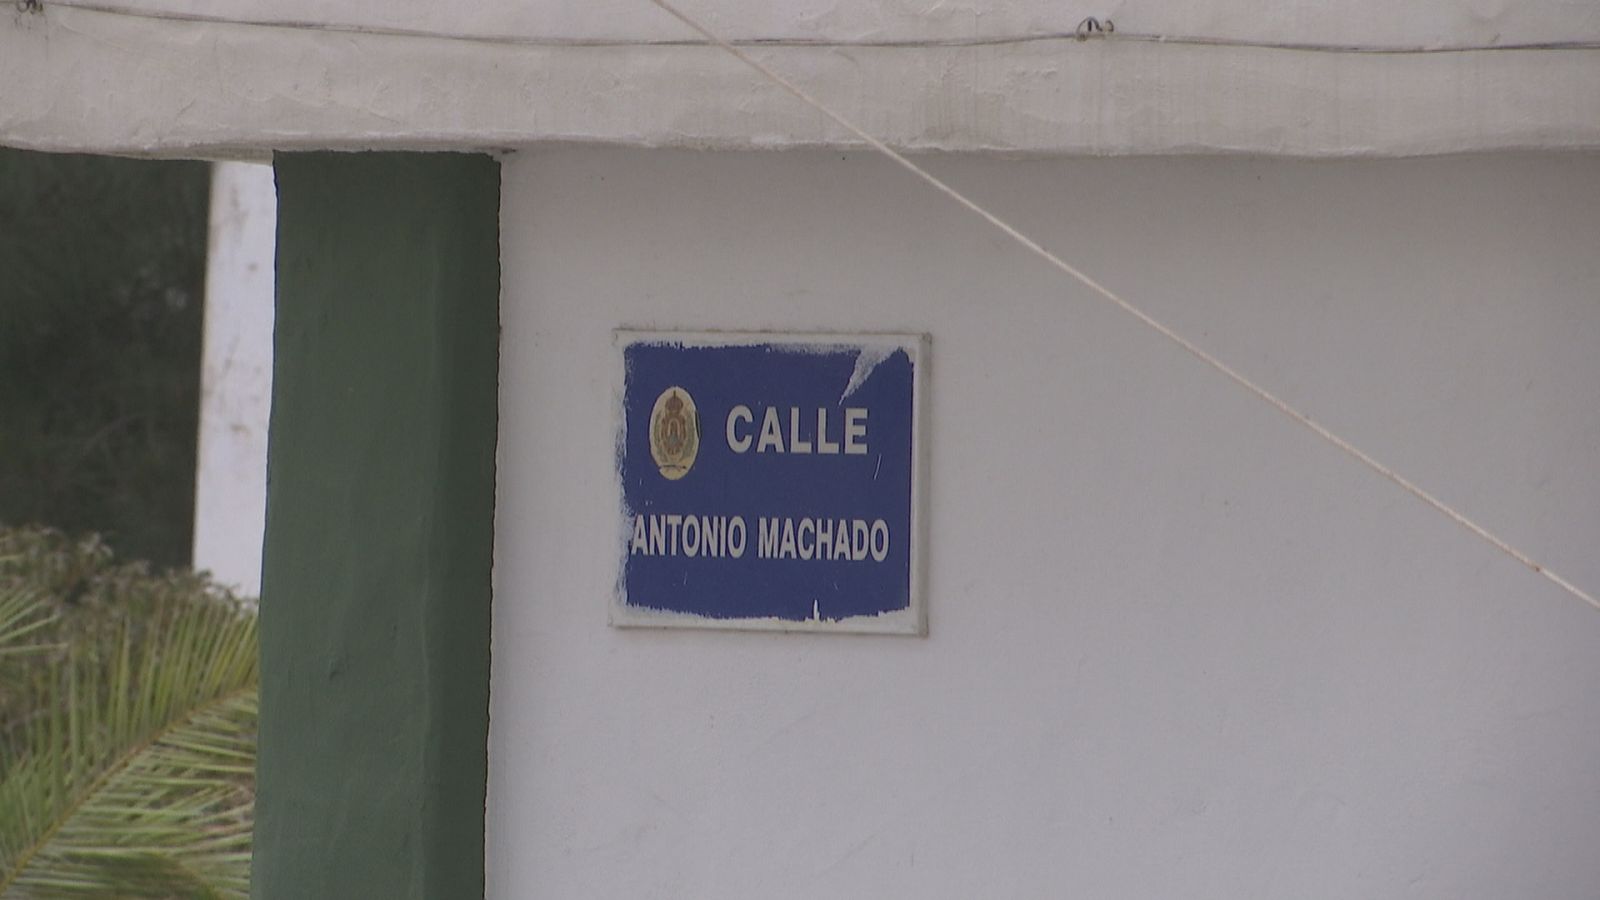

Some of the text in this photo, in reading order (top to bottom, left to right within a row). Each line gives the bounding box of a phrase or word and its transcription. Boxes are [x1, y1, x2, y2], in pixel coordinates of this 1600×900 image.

[726, 405, 868, 454] CALLE
[631, 514, 889, 562] ANTONIO MACHADO
